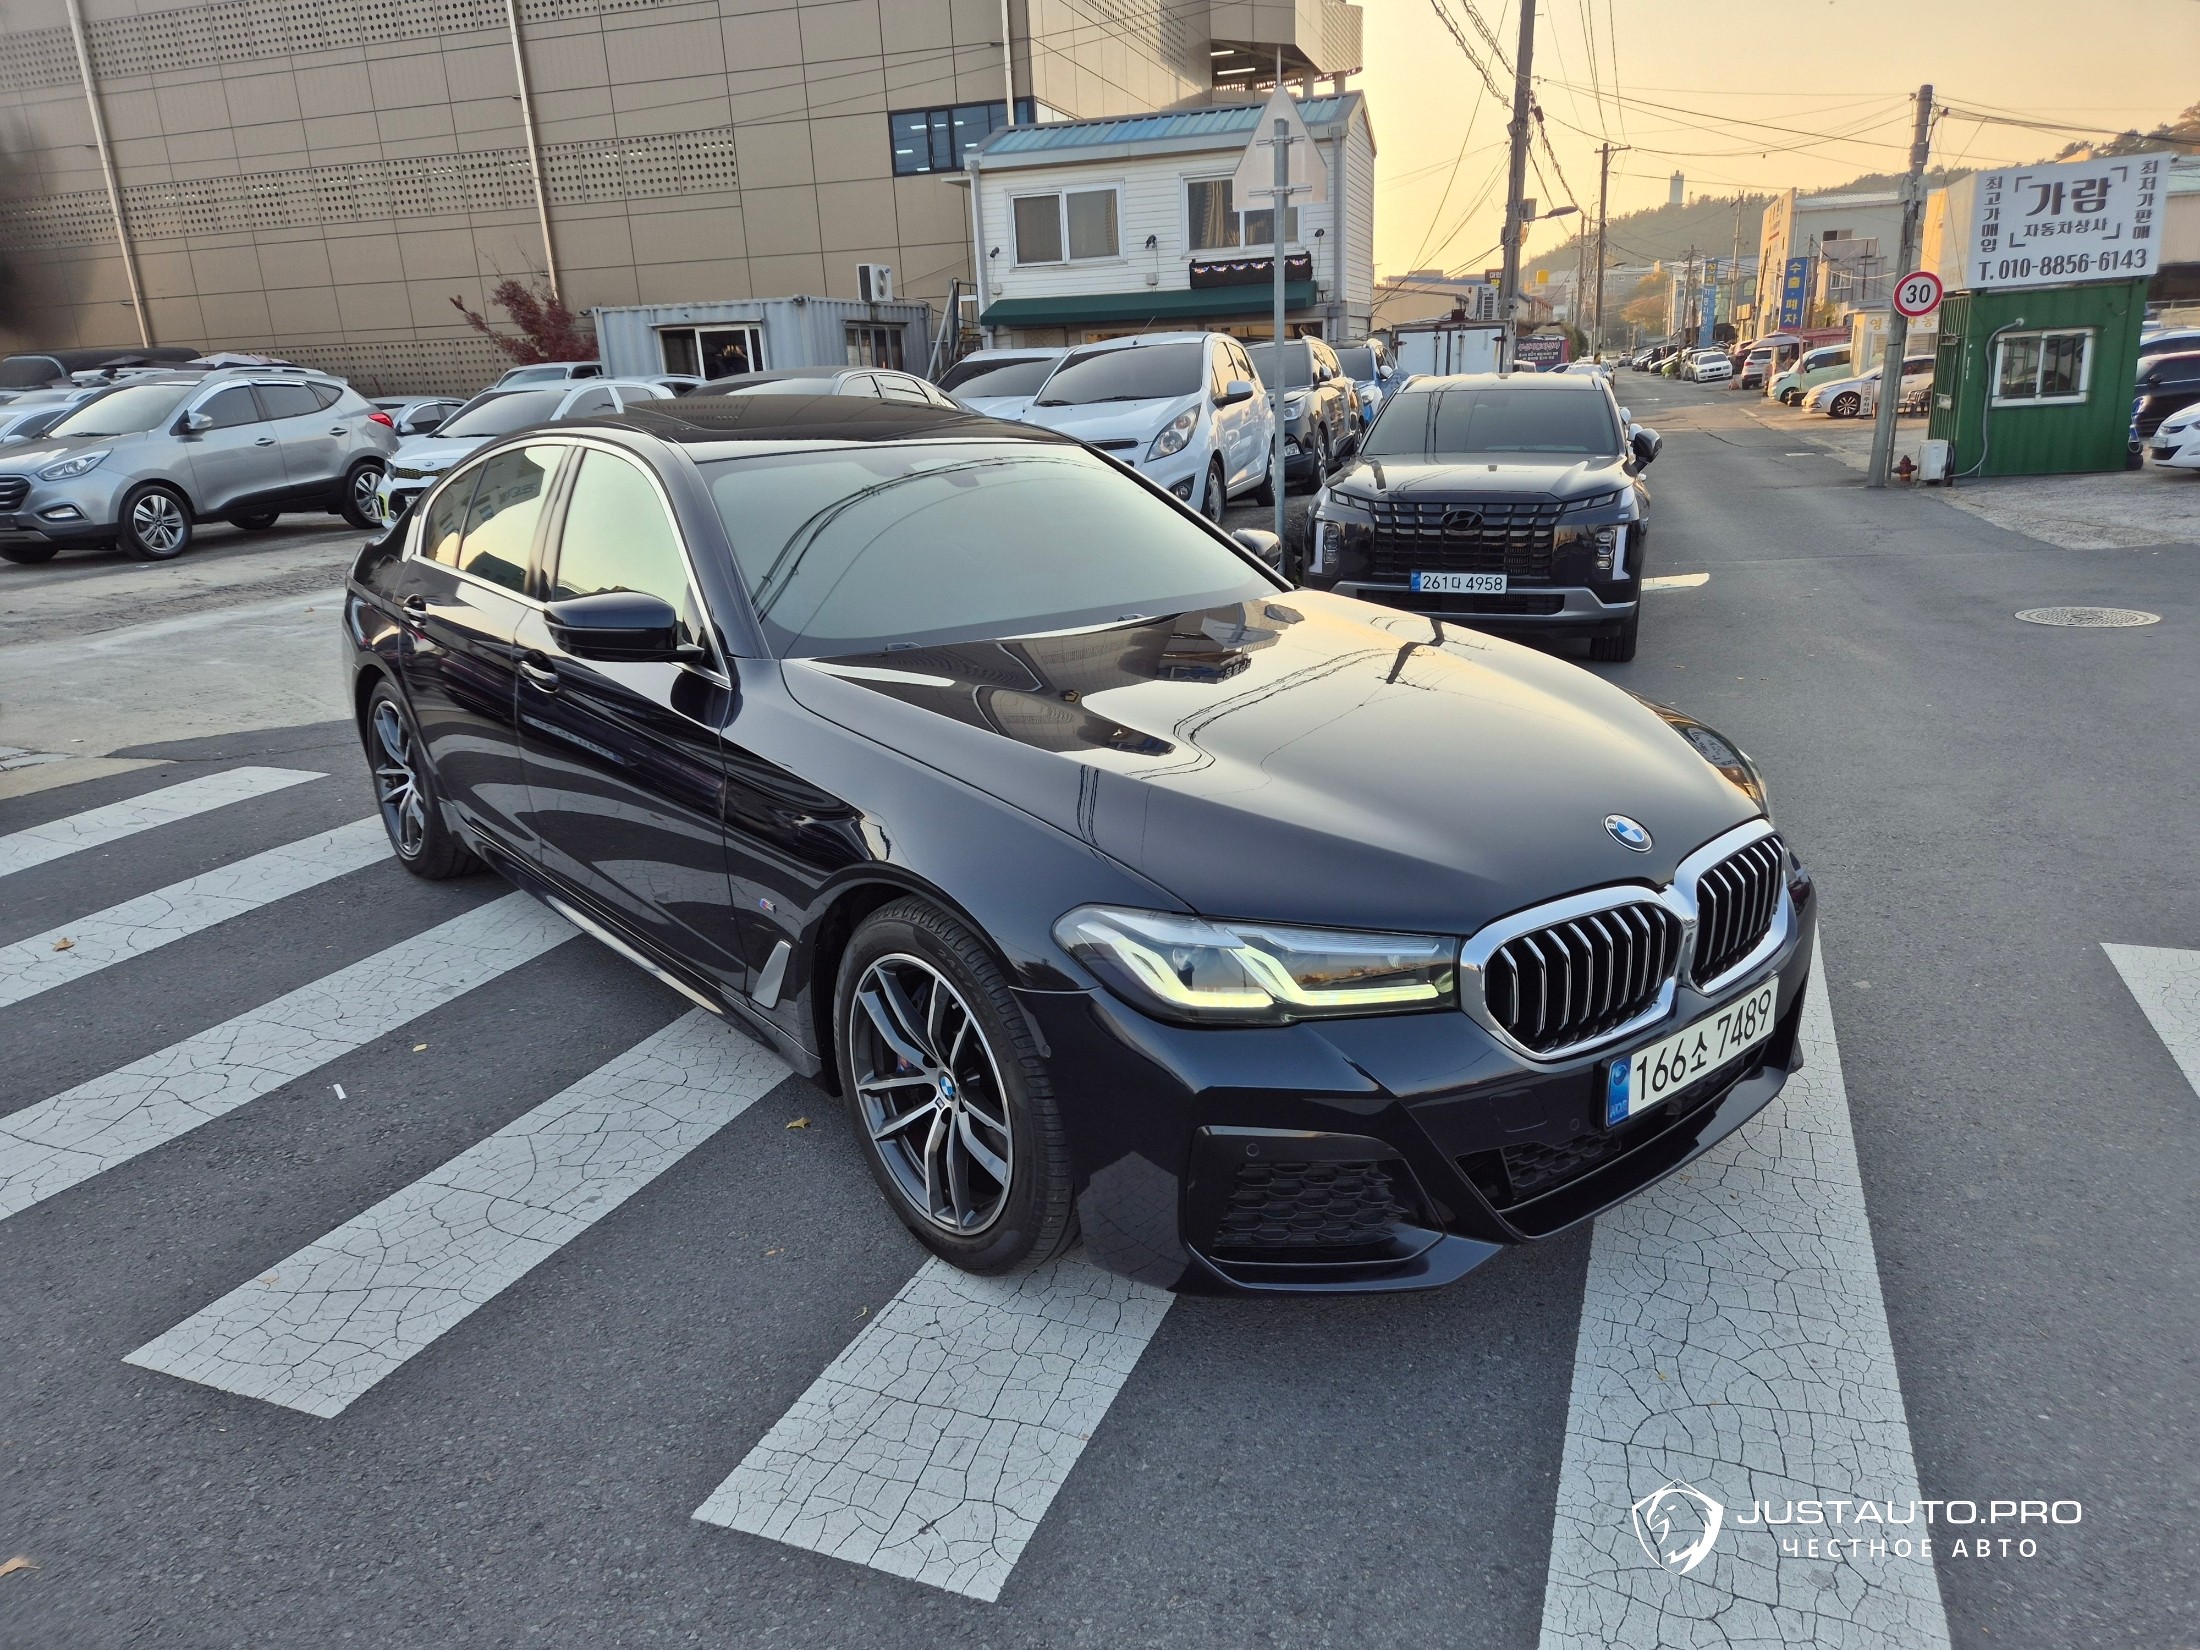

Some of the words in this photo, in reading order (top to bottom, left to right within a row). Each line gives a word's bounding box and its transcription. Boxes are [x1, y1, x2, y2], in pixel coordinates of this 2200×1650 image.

[1980, 175, 2003, 253] 최고가매입
[2025, 177, 2113, 217] 가람
[2131, 159, 2159, 240] 최저가판매
[2023, 217, 2108, 238] 자동차상사
[1905, 284, 1931, 305] 30
[1465, 576, 1503, 591] 4958
[1636, 1030, 1708, 1101] 166소
[1717, 988, 1772, 1059] 7489
